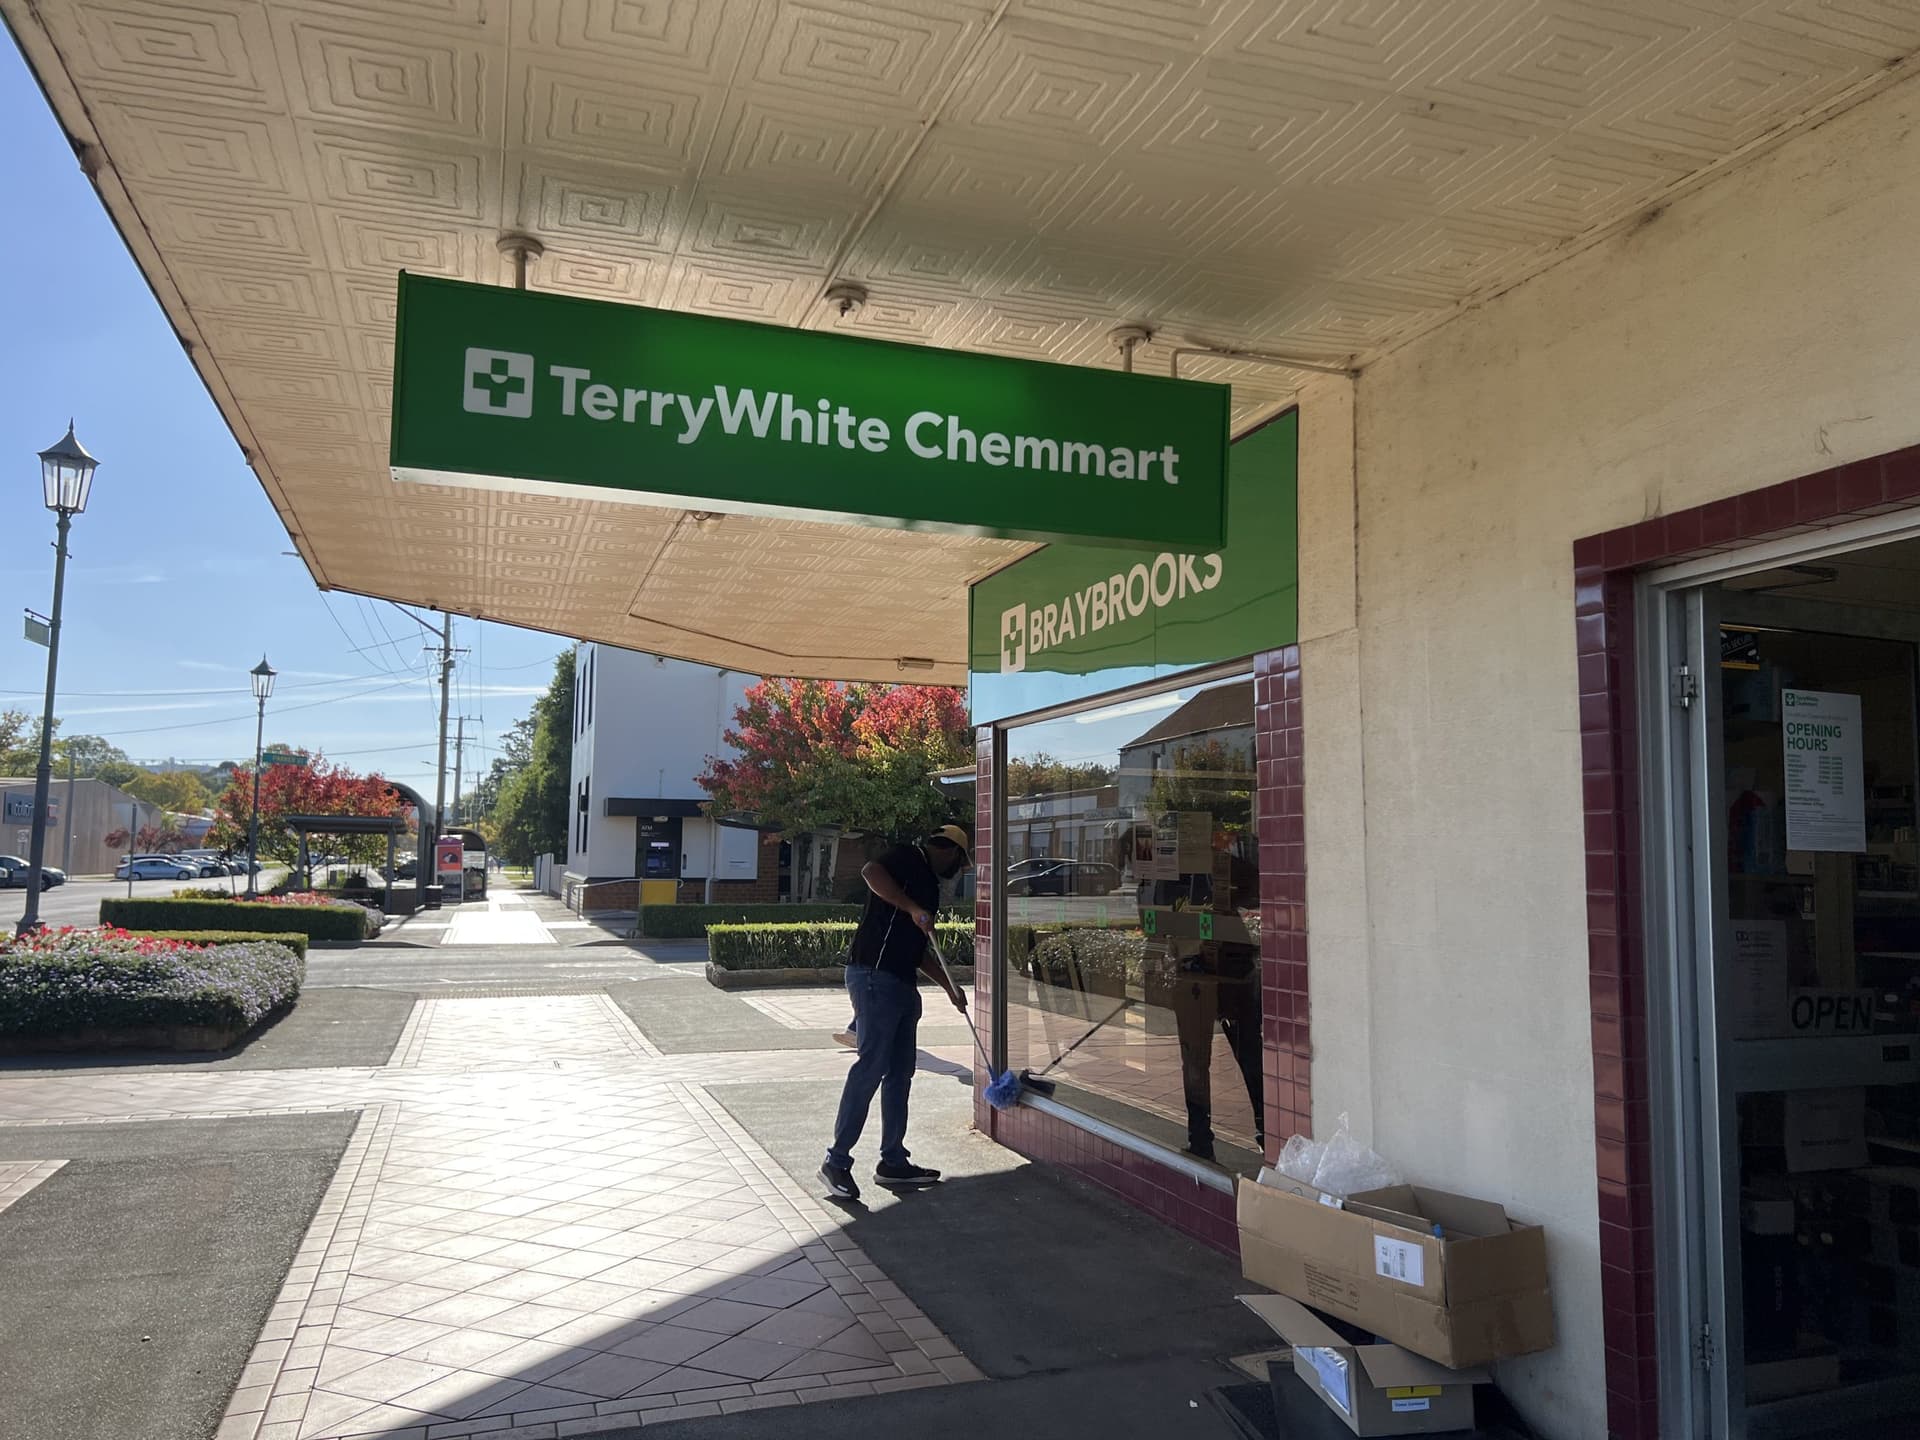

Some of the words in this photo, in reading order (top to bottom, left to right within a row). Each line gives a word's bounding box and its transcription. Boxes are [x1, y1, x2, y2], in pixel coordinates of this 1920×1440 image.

[550, 365, 890, 452] TerryWhite
[904, 410, 1180, 485] Chemmart
[1030, 553, 1223, 654] BRAYBROOKS
[1786, 722, 1842, 738] OPENING
[1787, 737, 1828, 751] HOURS
[1791, 996, 1873, 1030] OPEN
